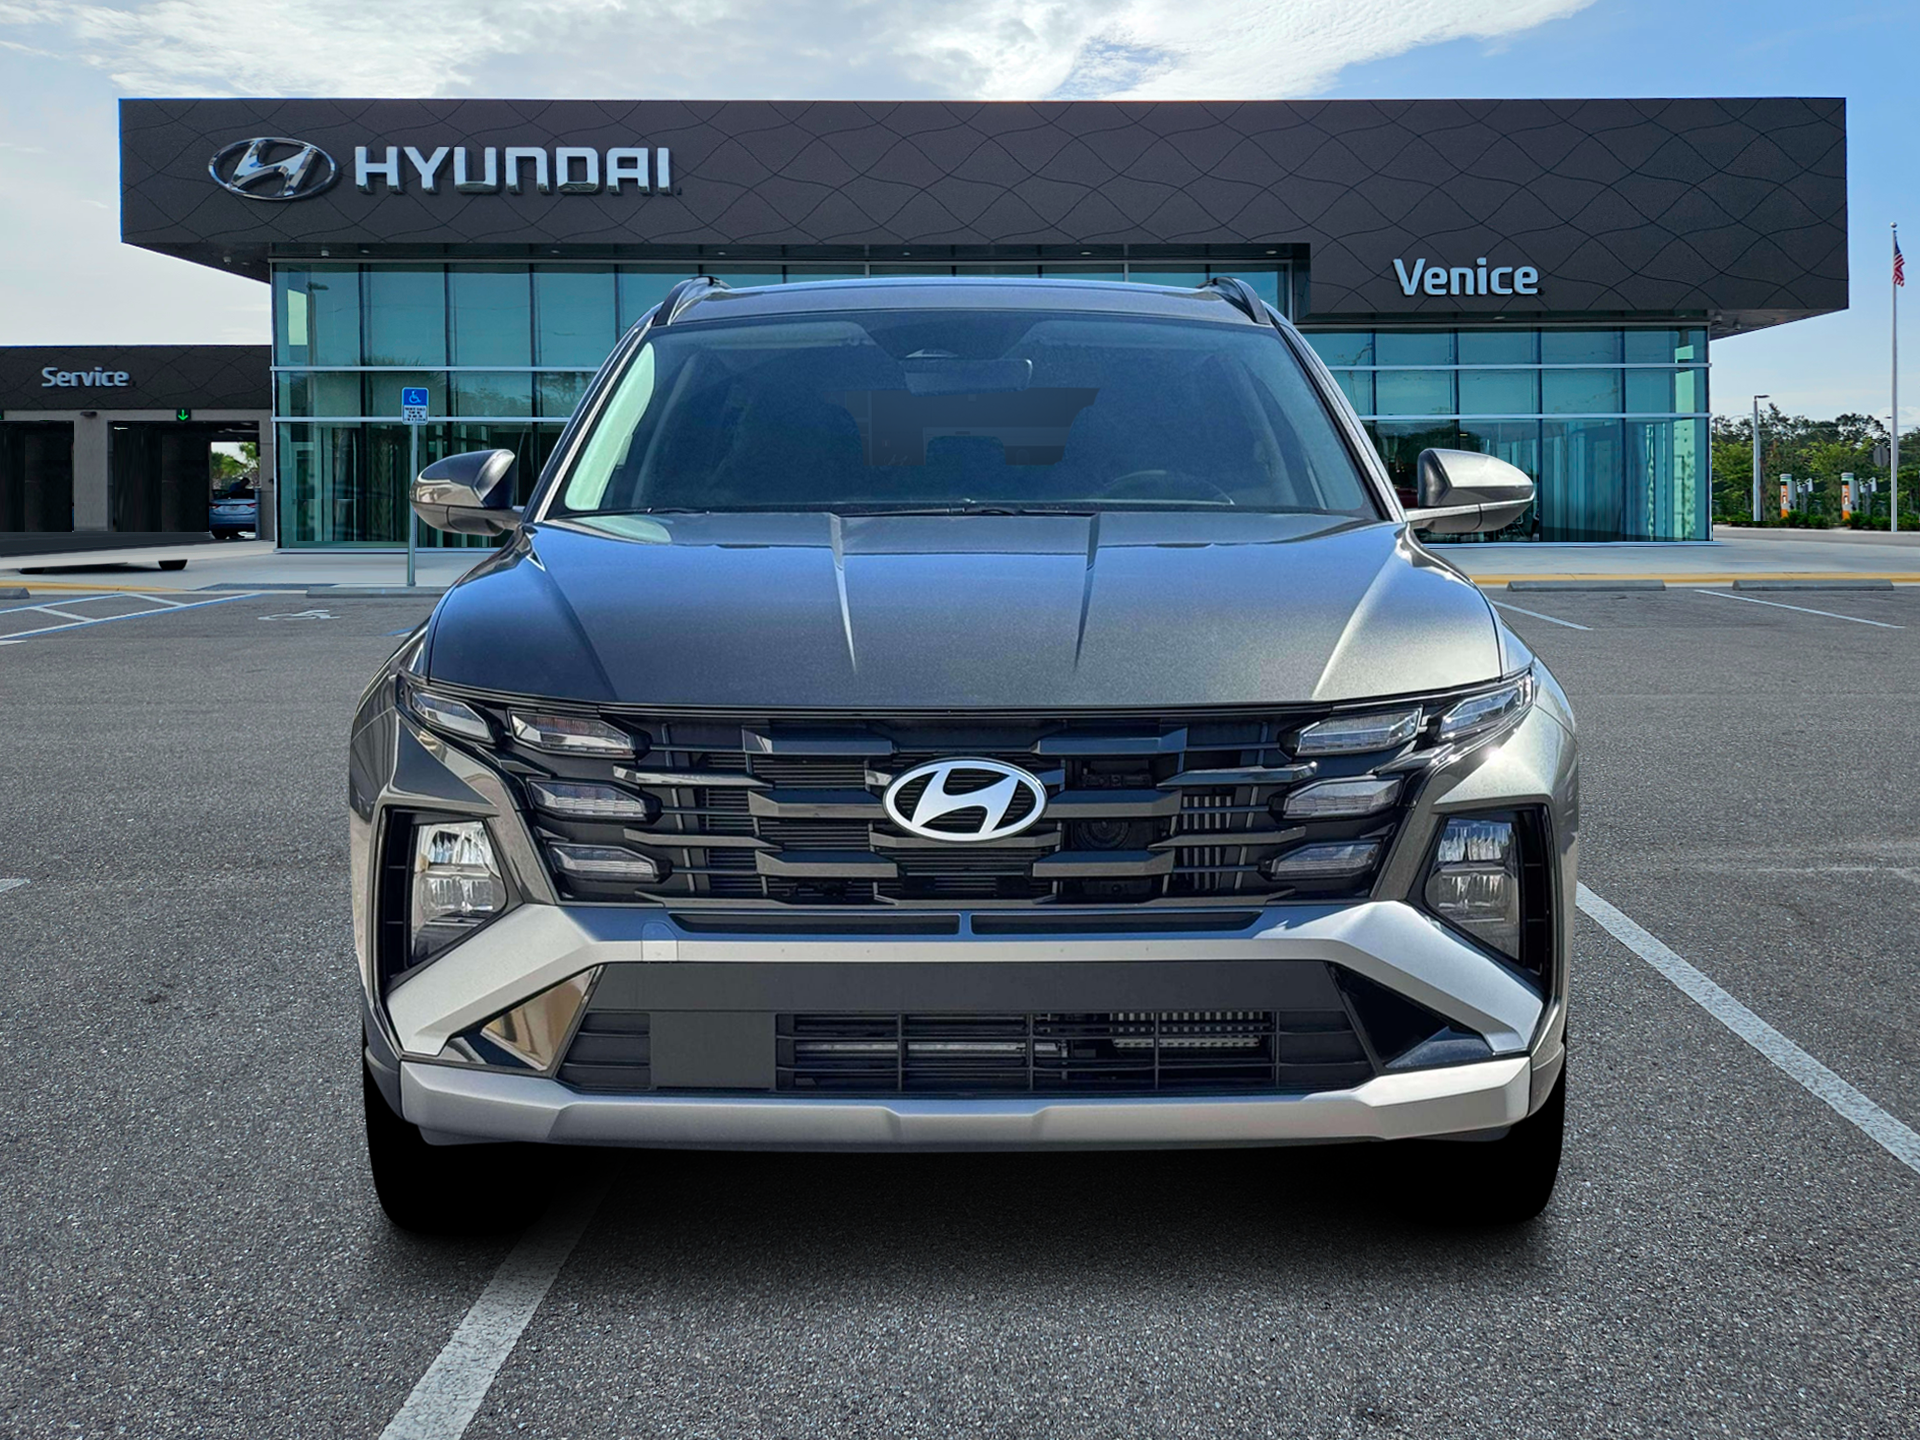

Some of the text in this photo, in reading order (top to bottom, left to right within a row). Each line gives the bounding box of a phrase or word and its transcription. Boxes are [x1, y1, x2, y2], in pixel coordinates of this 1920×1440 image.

[354, 146, 670, 195] HYUNDAI
[1392, 256, 1539, 296] Venice
[41, 366, 130, 387] Service
